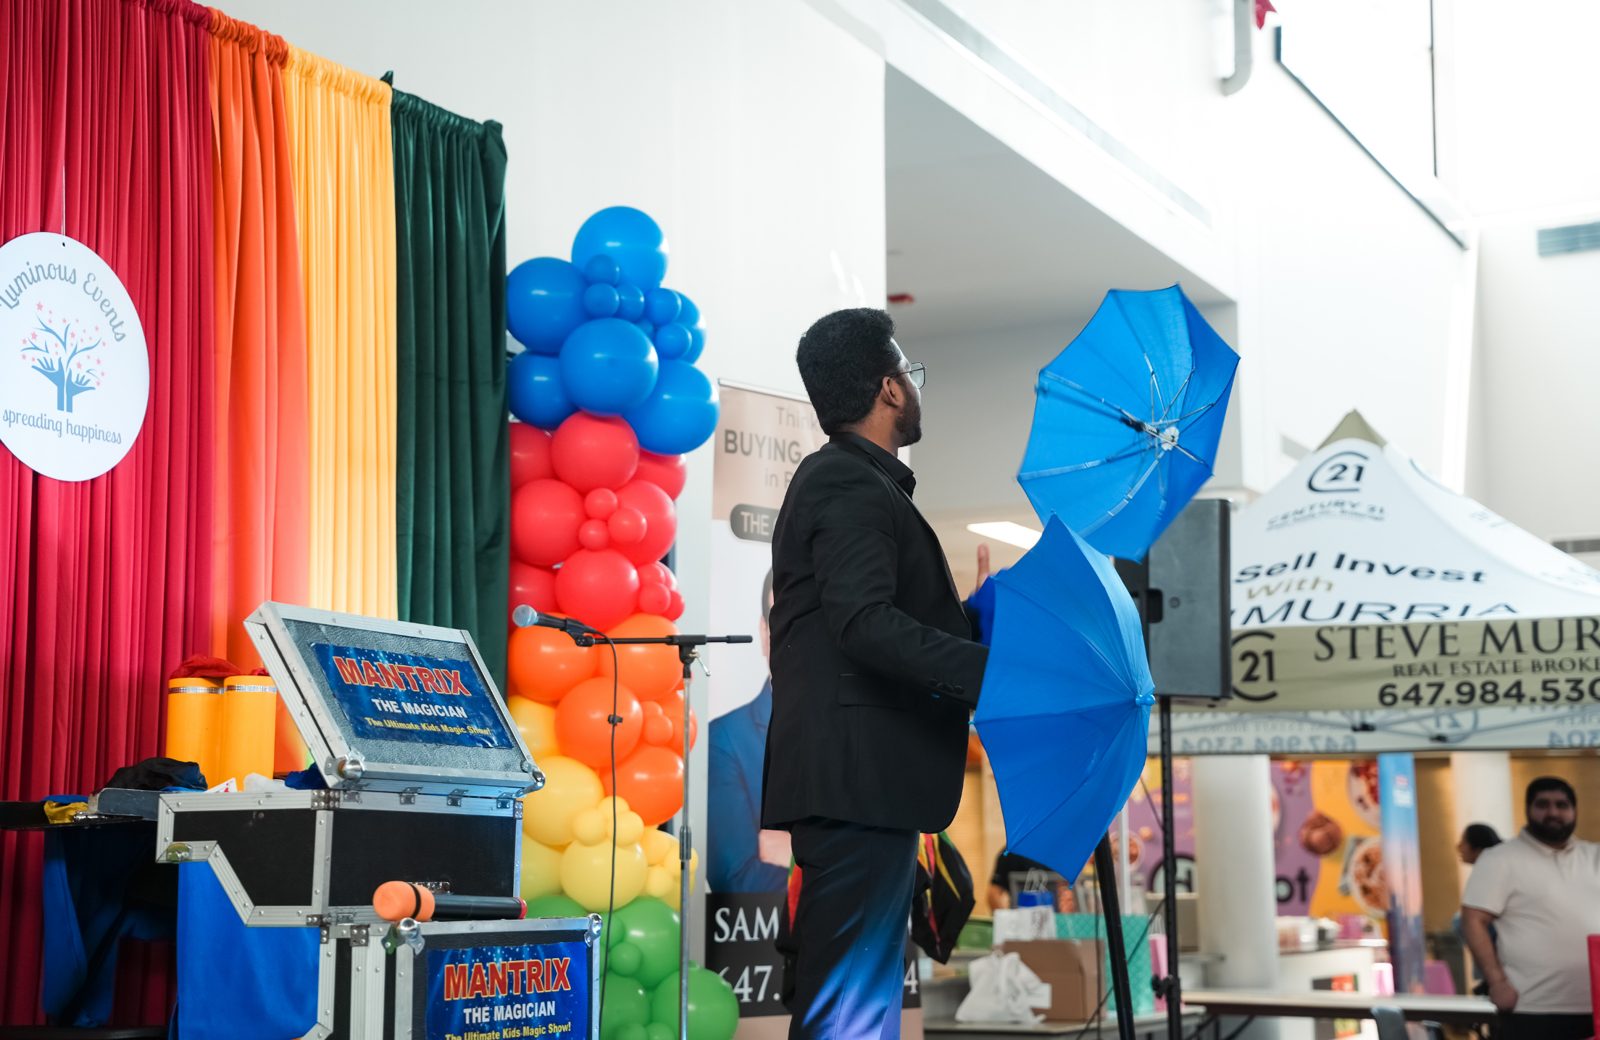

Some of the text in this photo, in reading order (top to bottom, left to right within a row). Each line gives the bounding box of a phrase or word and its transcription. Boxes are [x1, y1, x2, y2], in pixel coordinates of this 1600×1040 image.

[0, 261, 126, 342] Luminous Events
[2, 408, 122, 444] spreading happiness
[724, 429, 802, 464] BUYING
[740, 511, 770, 536] THE
[1235, 551, 1486, 584] Sell Invest
[1246, 576, 1334, 600] With
[1314, 617, 1600, 662] STEVE MUR
[332, 656, 472, 697] MANTRIX
[1392, 663, 1443, 678] REAL
[1449, 660, 1523, 676] ESTATE
[371, 698, 467, 719] THE MAGICIAN
[364, 717, 384, 727] The
[385, 719, 420, 731] Ultimate
[421, 722, 440, 733] Kids
[440, 724, 465, 736] Magic
[713, 906, 780, 943] SAM
[443, 957, 572, 1001] MANTRIX
[719, 965, 781, 1003] 47.
[463, 1000, 556, 1024] THE MAGICIAN
[502, 1027, 520, 1039] Kids
[522, 1024, 547, 1038] Magic
[547, 1021, 572, 1034] Show!
